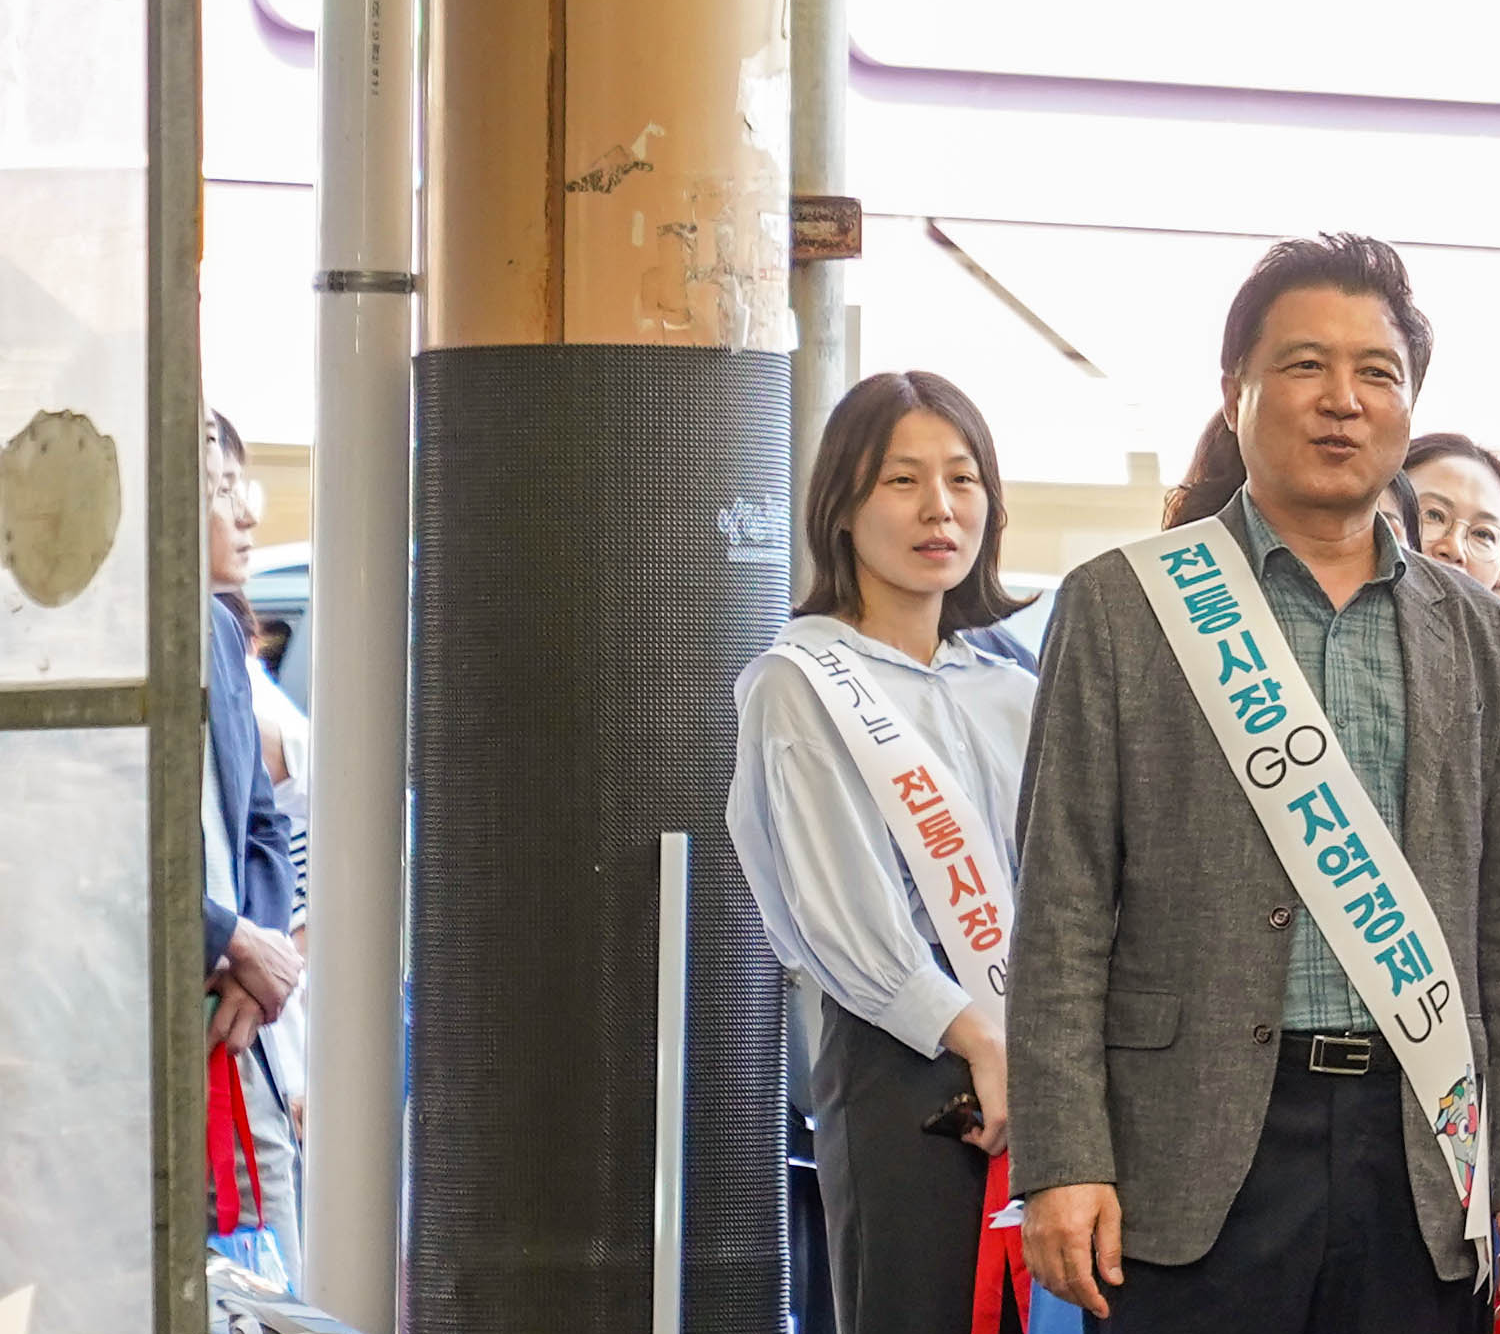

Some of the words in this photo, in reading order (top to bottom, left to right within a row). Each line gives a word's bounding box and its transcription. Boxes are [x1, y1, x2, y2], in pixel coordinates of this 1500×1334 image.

[1159, 541, 1289, 736] 전통시장
[1245, 723, 1328, 790] GO
[891, 764, 1004, 953] 전통시장
[1286, 780, 1435, 998] 지역경제
[1394, 978, 1451, 1045] UP
